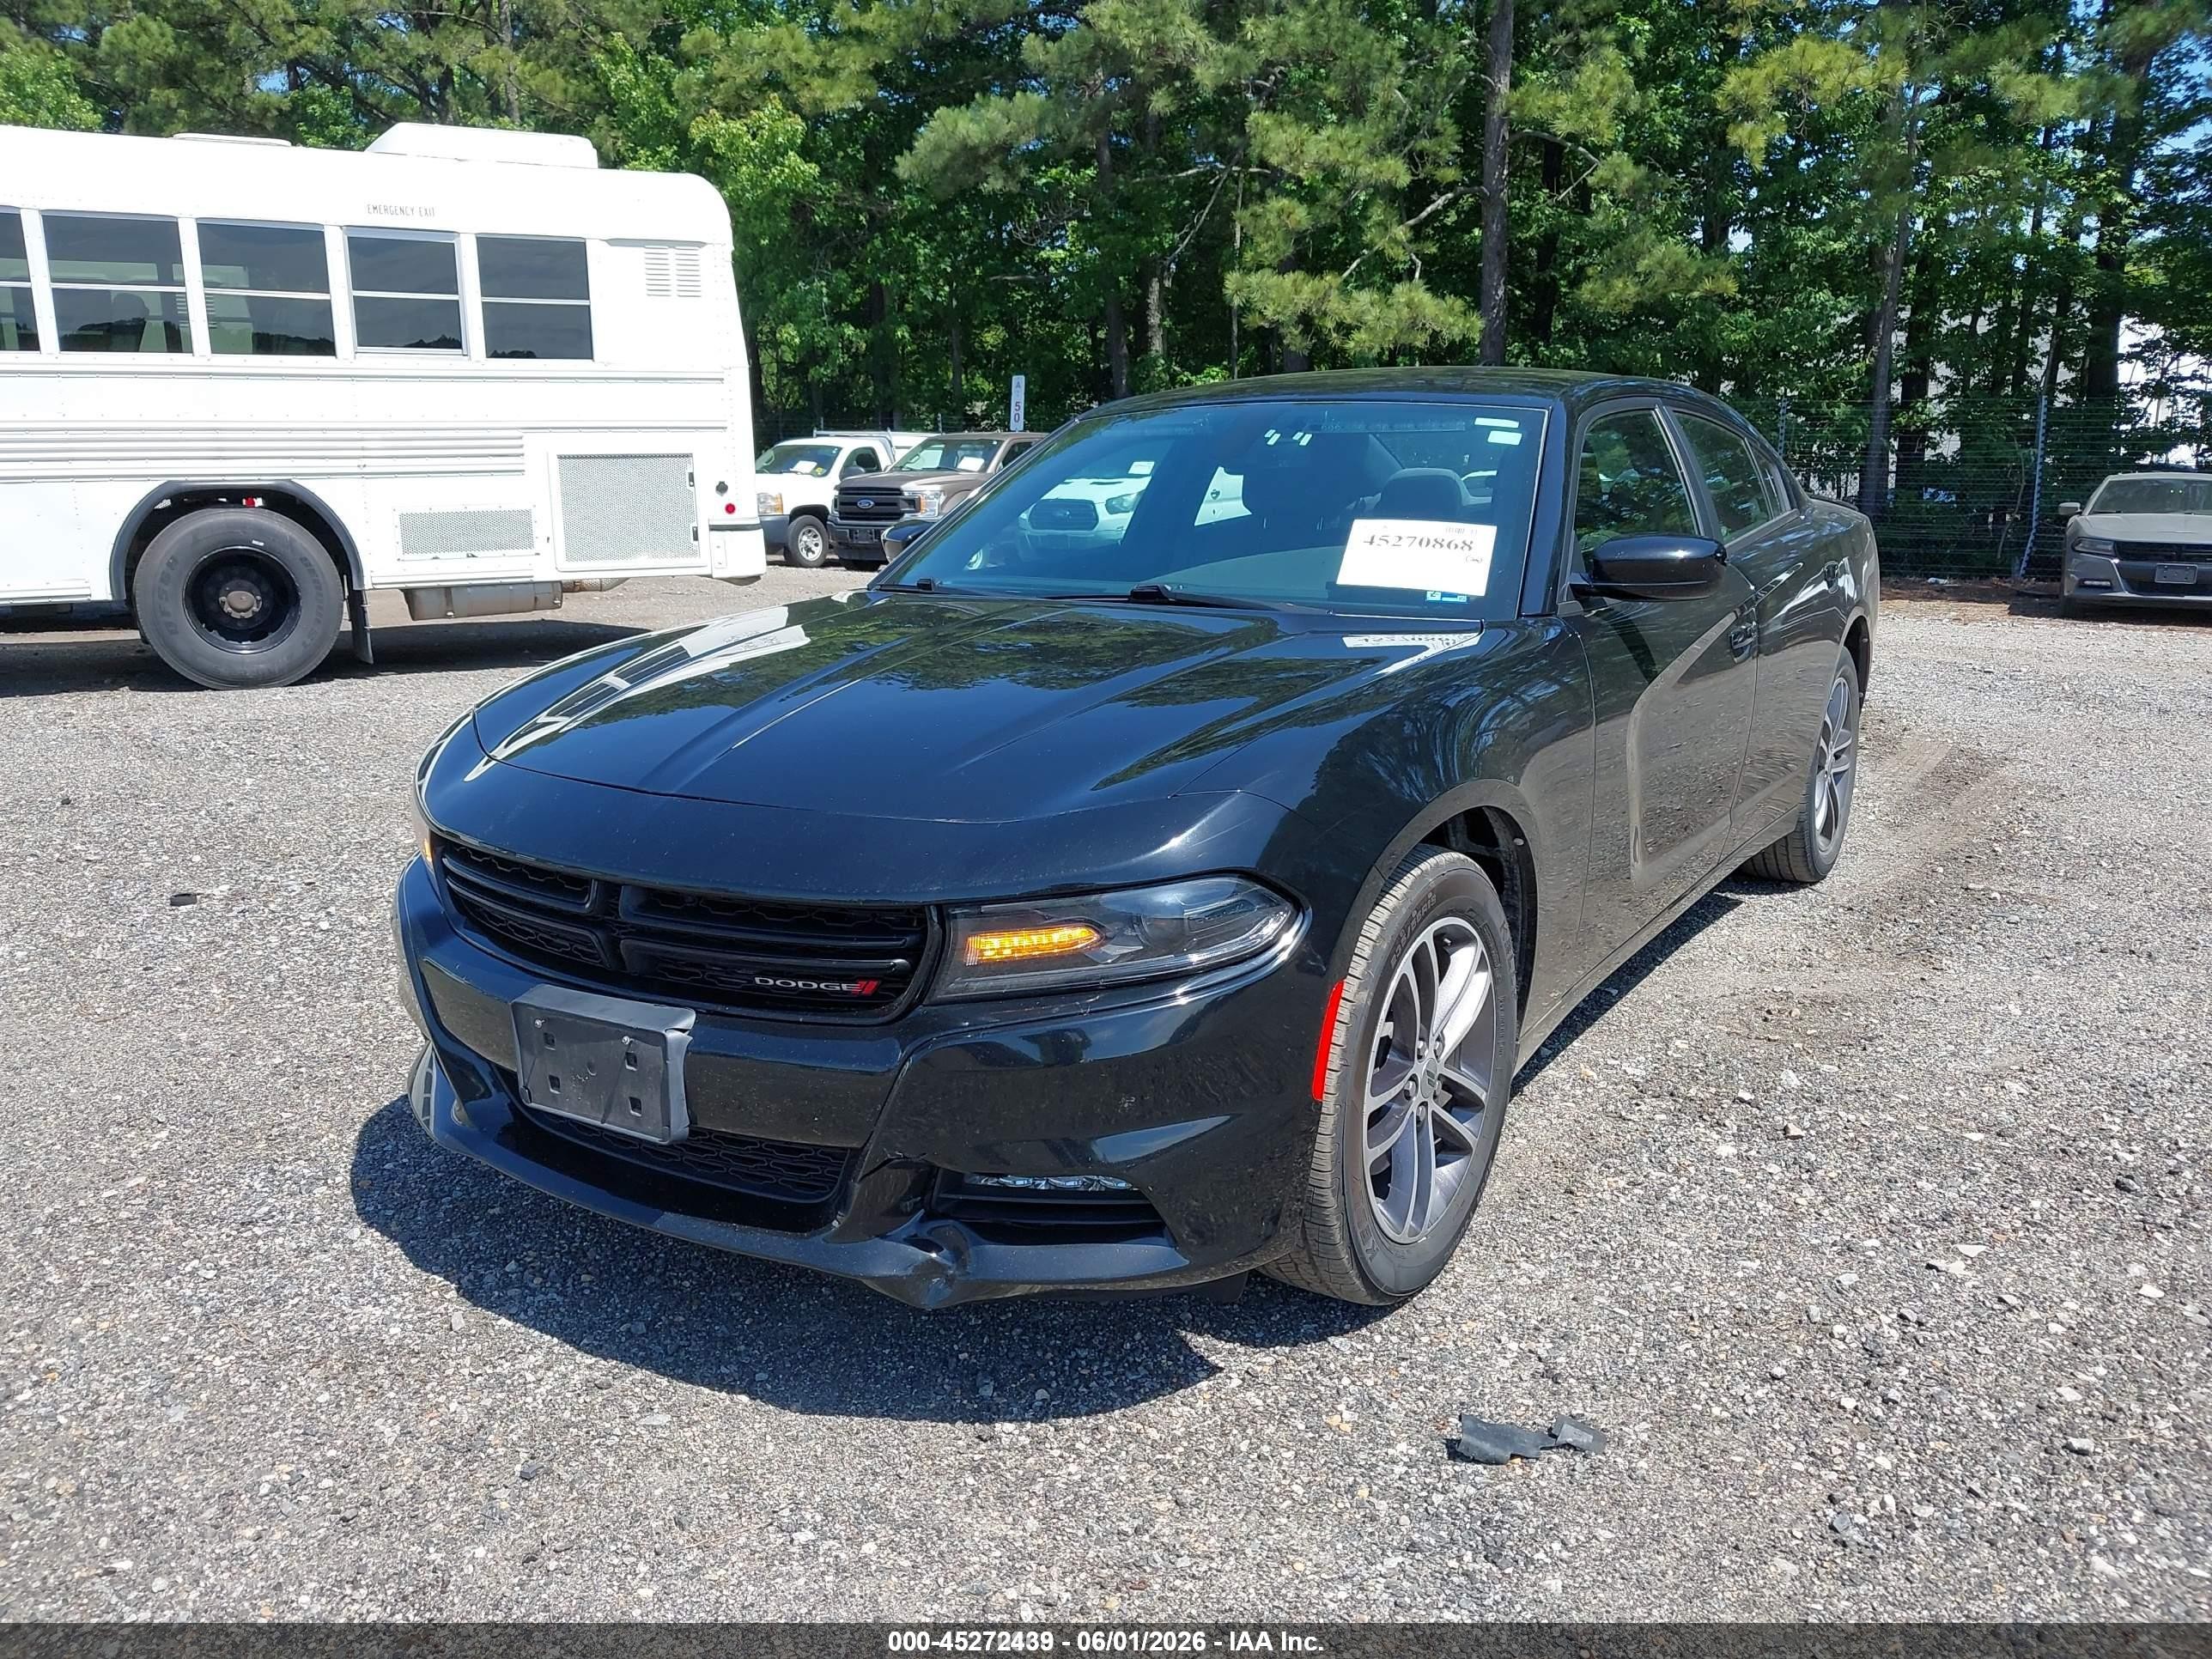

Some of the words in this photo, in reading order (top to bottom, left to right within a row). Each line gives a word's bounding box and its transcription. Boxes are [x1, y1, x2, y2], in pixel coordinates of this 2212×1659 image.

[367, 204, 414, 216] EMERGENCY
[1013, 401, 1021, 423] 50
[1364, 533, 1474, 552] 45270868
[755, 976, 862, 992] DODGE
